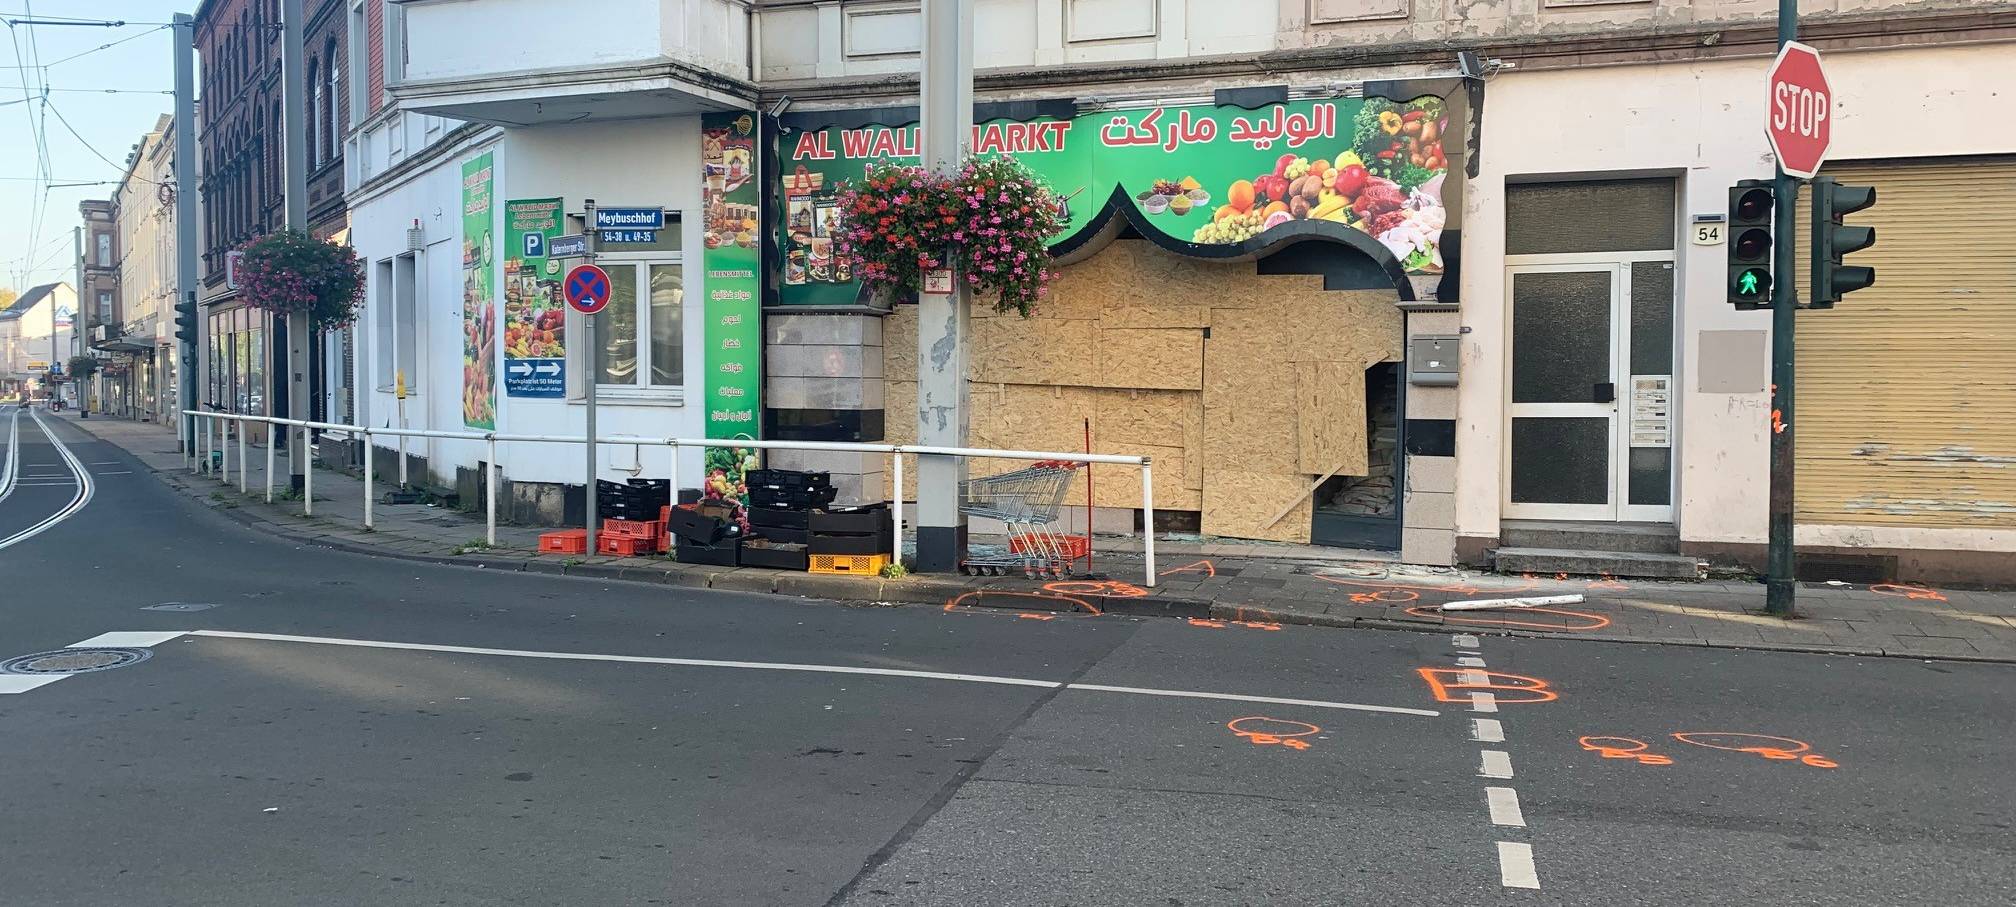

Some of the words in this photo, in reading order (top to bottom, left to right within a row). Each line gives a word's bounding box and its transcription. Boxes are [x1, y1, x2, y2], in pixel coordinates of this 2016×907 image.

[1774, 81, 1827, 139] STOP
[1100, 107, 1218, 152] ماركت
[1230, 103, 1336, 150] الوليد
[792, 130, 836, 161] AL
[598, 212, 656, 226] Meybuschhof
[527, 236, 539, 254] P
[605, 231, 622, 241] 54-38
[1699, 227, 1719, 241] 54
[709, 269, 753, 278] LEBENSMITTEL
[1416, 666, 1559, 703] B
